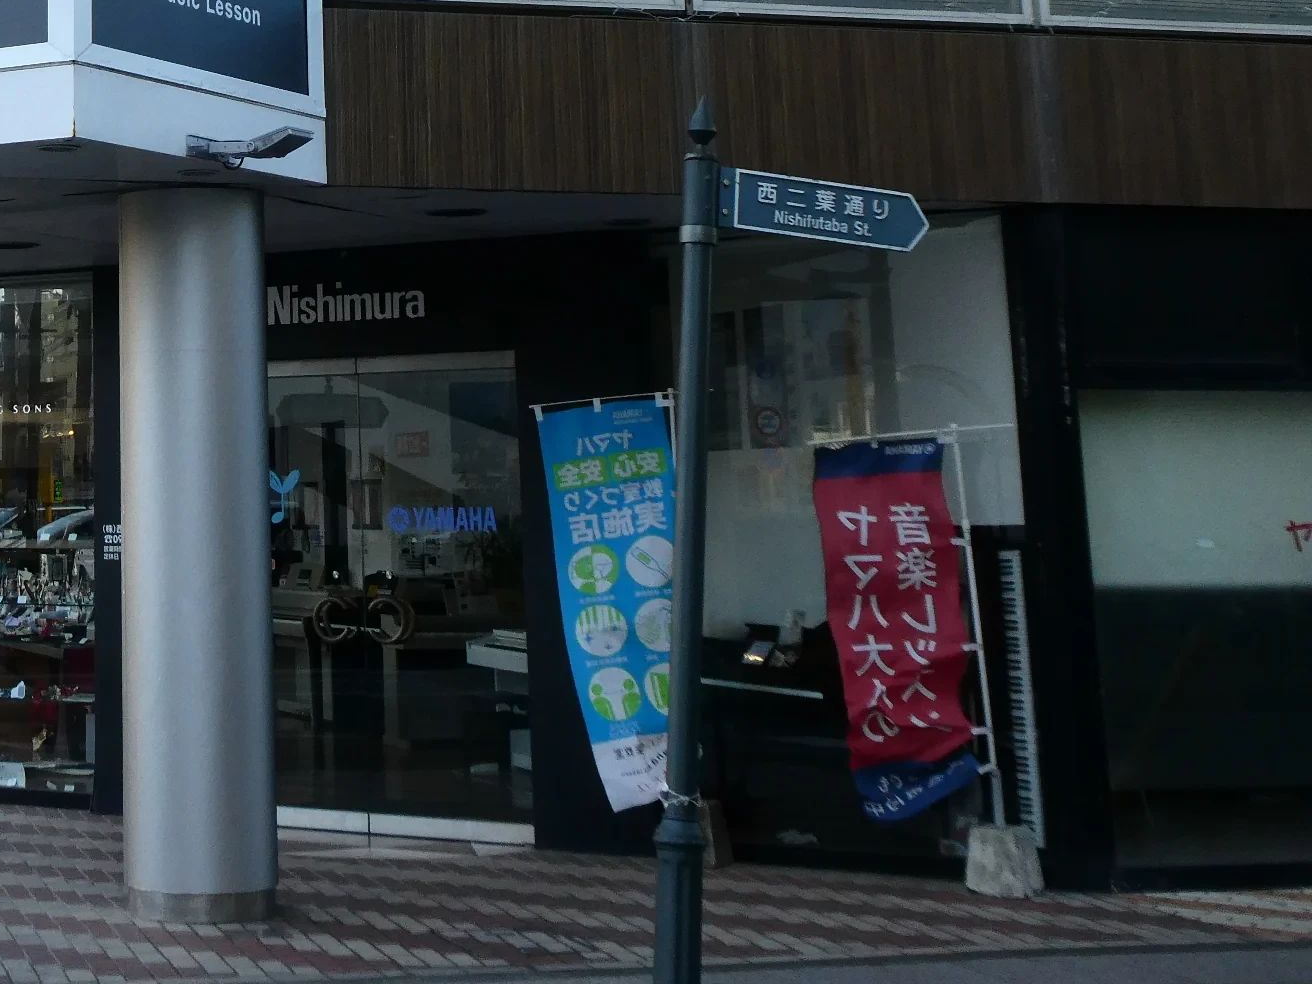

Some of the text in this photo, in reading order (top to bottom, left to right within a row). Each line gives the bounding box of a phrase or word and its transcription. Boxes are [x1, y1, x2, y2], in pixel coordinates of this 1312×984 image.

[757, 181, 889, 220] 西二葉通り
[774, 209, 872, 237] Nishifutaba St.
[266, 281, 426, 326] Nishimura
[12, 403, 52, 414] SONS
[411, 506, 497, 532] YAMAHA
